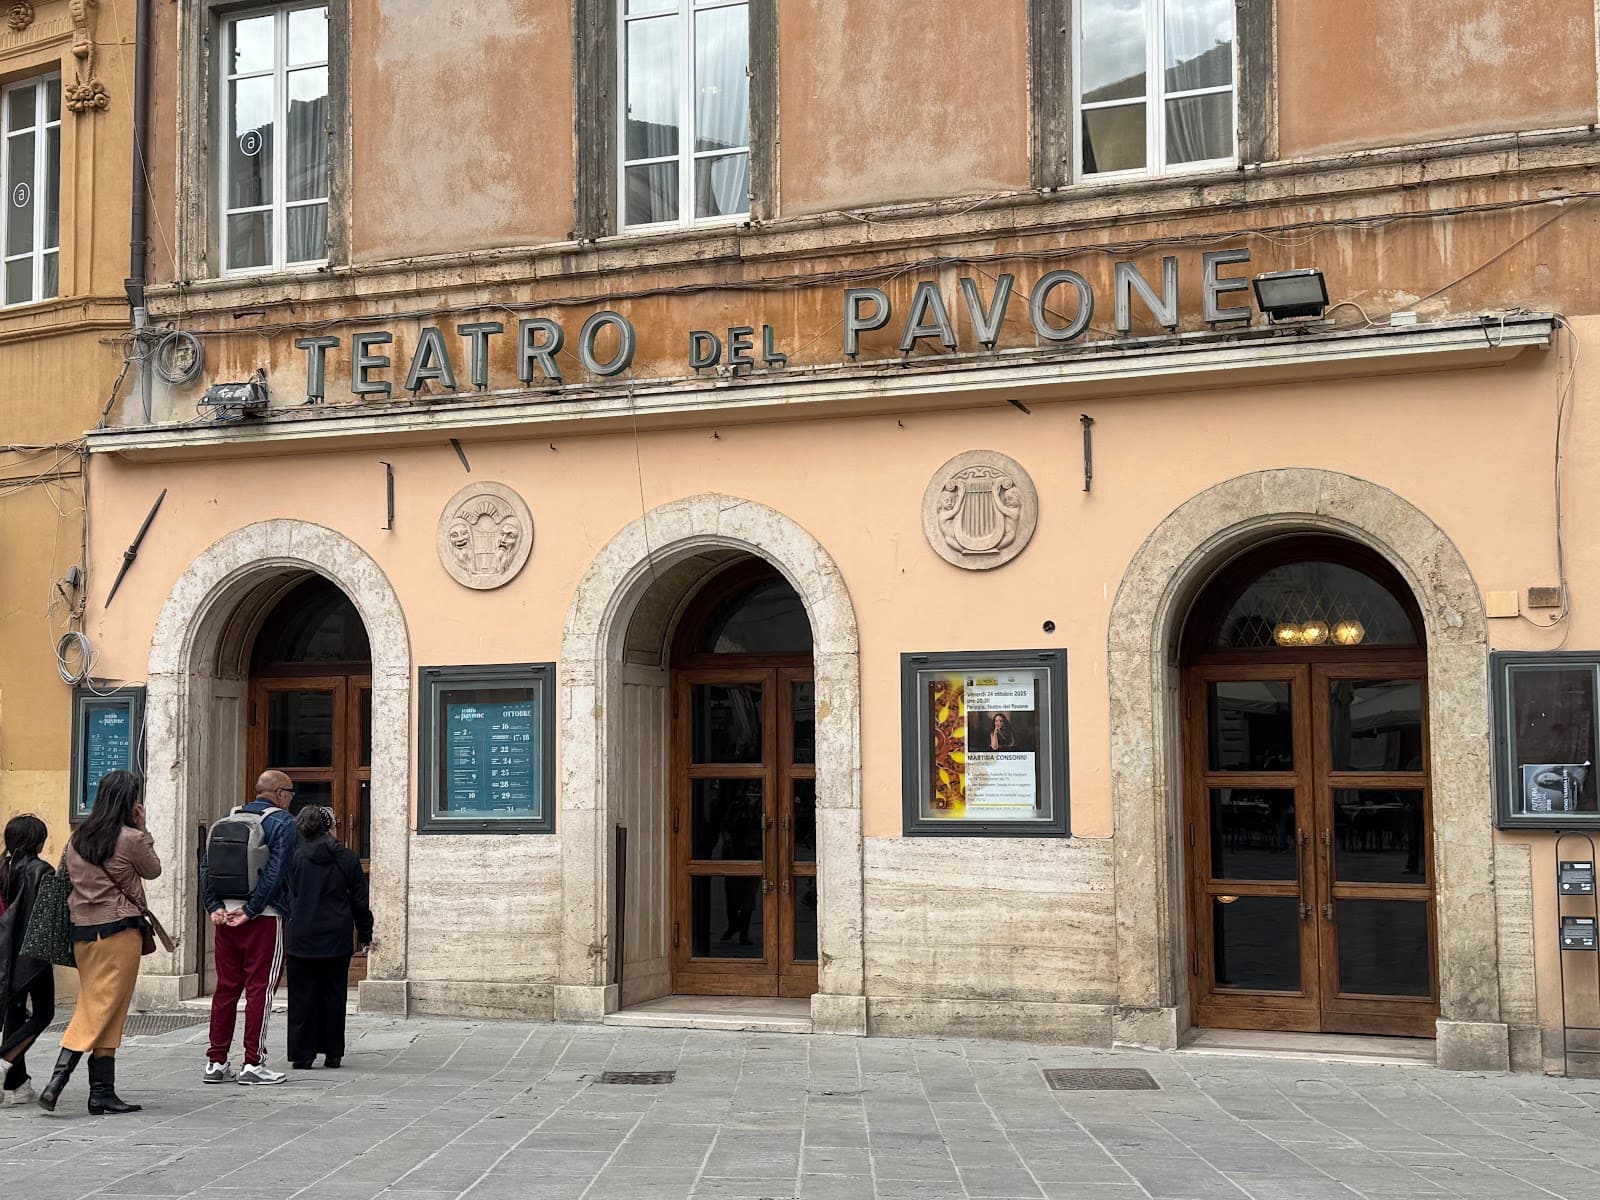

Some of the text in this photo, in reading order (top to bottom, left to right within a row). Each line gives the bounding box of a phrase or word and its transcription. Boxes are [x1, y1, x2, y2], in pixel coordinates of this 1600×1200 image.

[295, 248, 1252, 398] TEATRO DEL PAVONE
